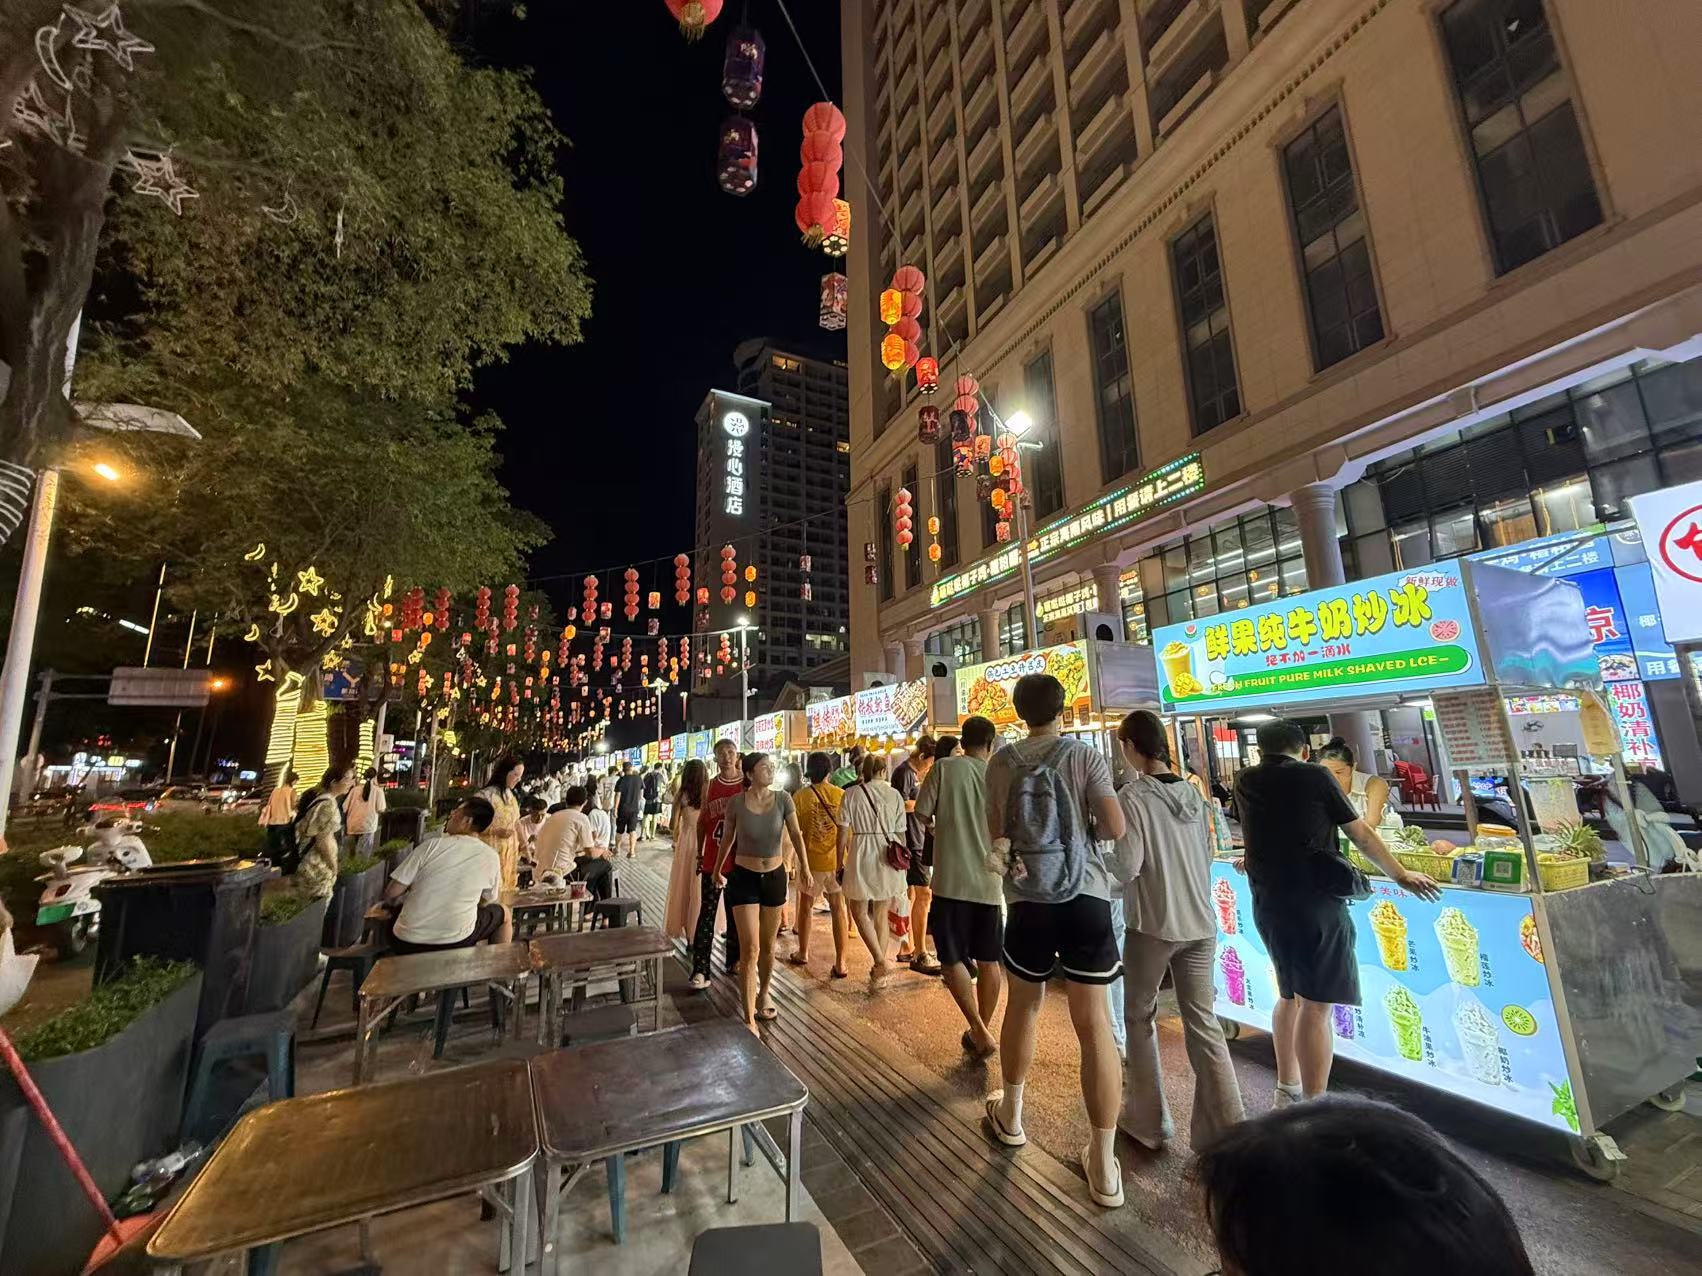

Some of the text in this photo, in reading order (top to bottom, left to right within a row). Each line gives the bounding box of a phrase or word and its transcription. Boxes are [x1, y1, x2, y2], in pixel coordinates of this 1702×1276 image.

[1204, 583, 1434, 661] 鲜果纯牛奶炒冰
[1245, 677, 1276, 688] FRUIT
[1279, 671, 1310, 683] PURE
[1313, 666, 1344, 679] MILK
[1347, 660, 1406, 675] SHAVED
